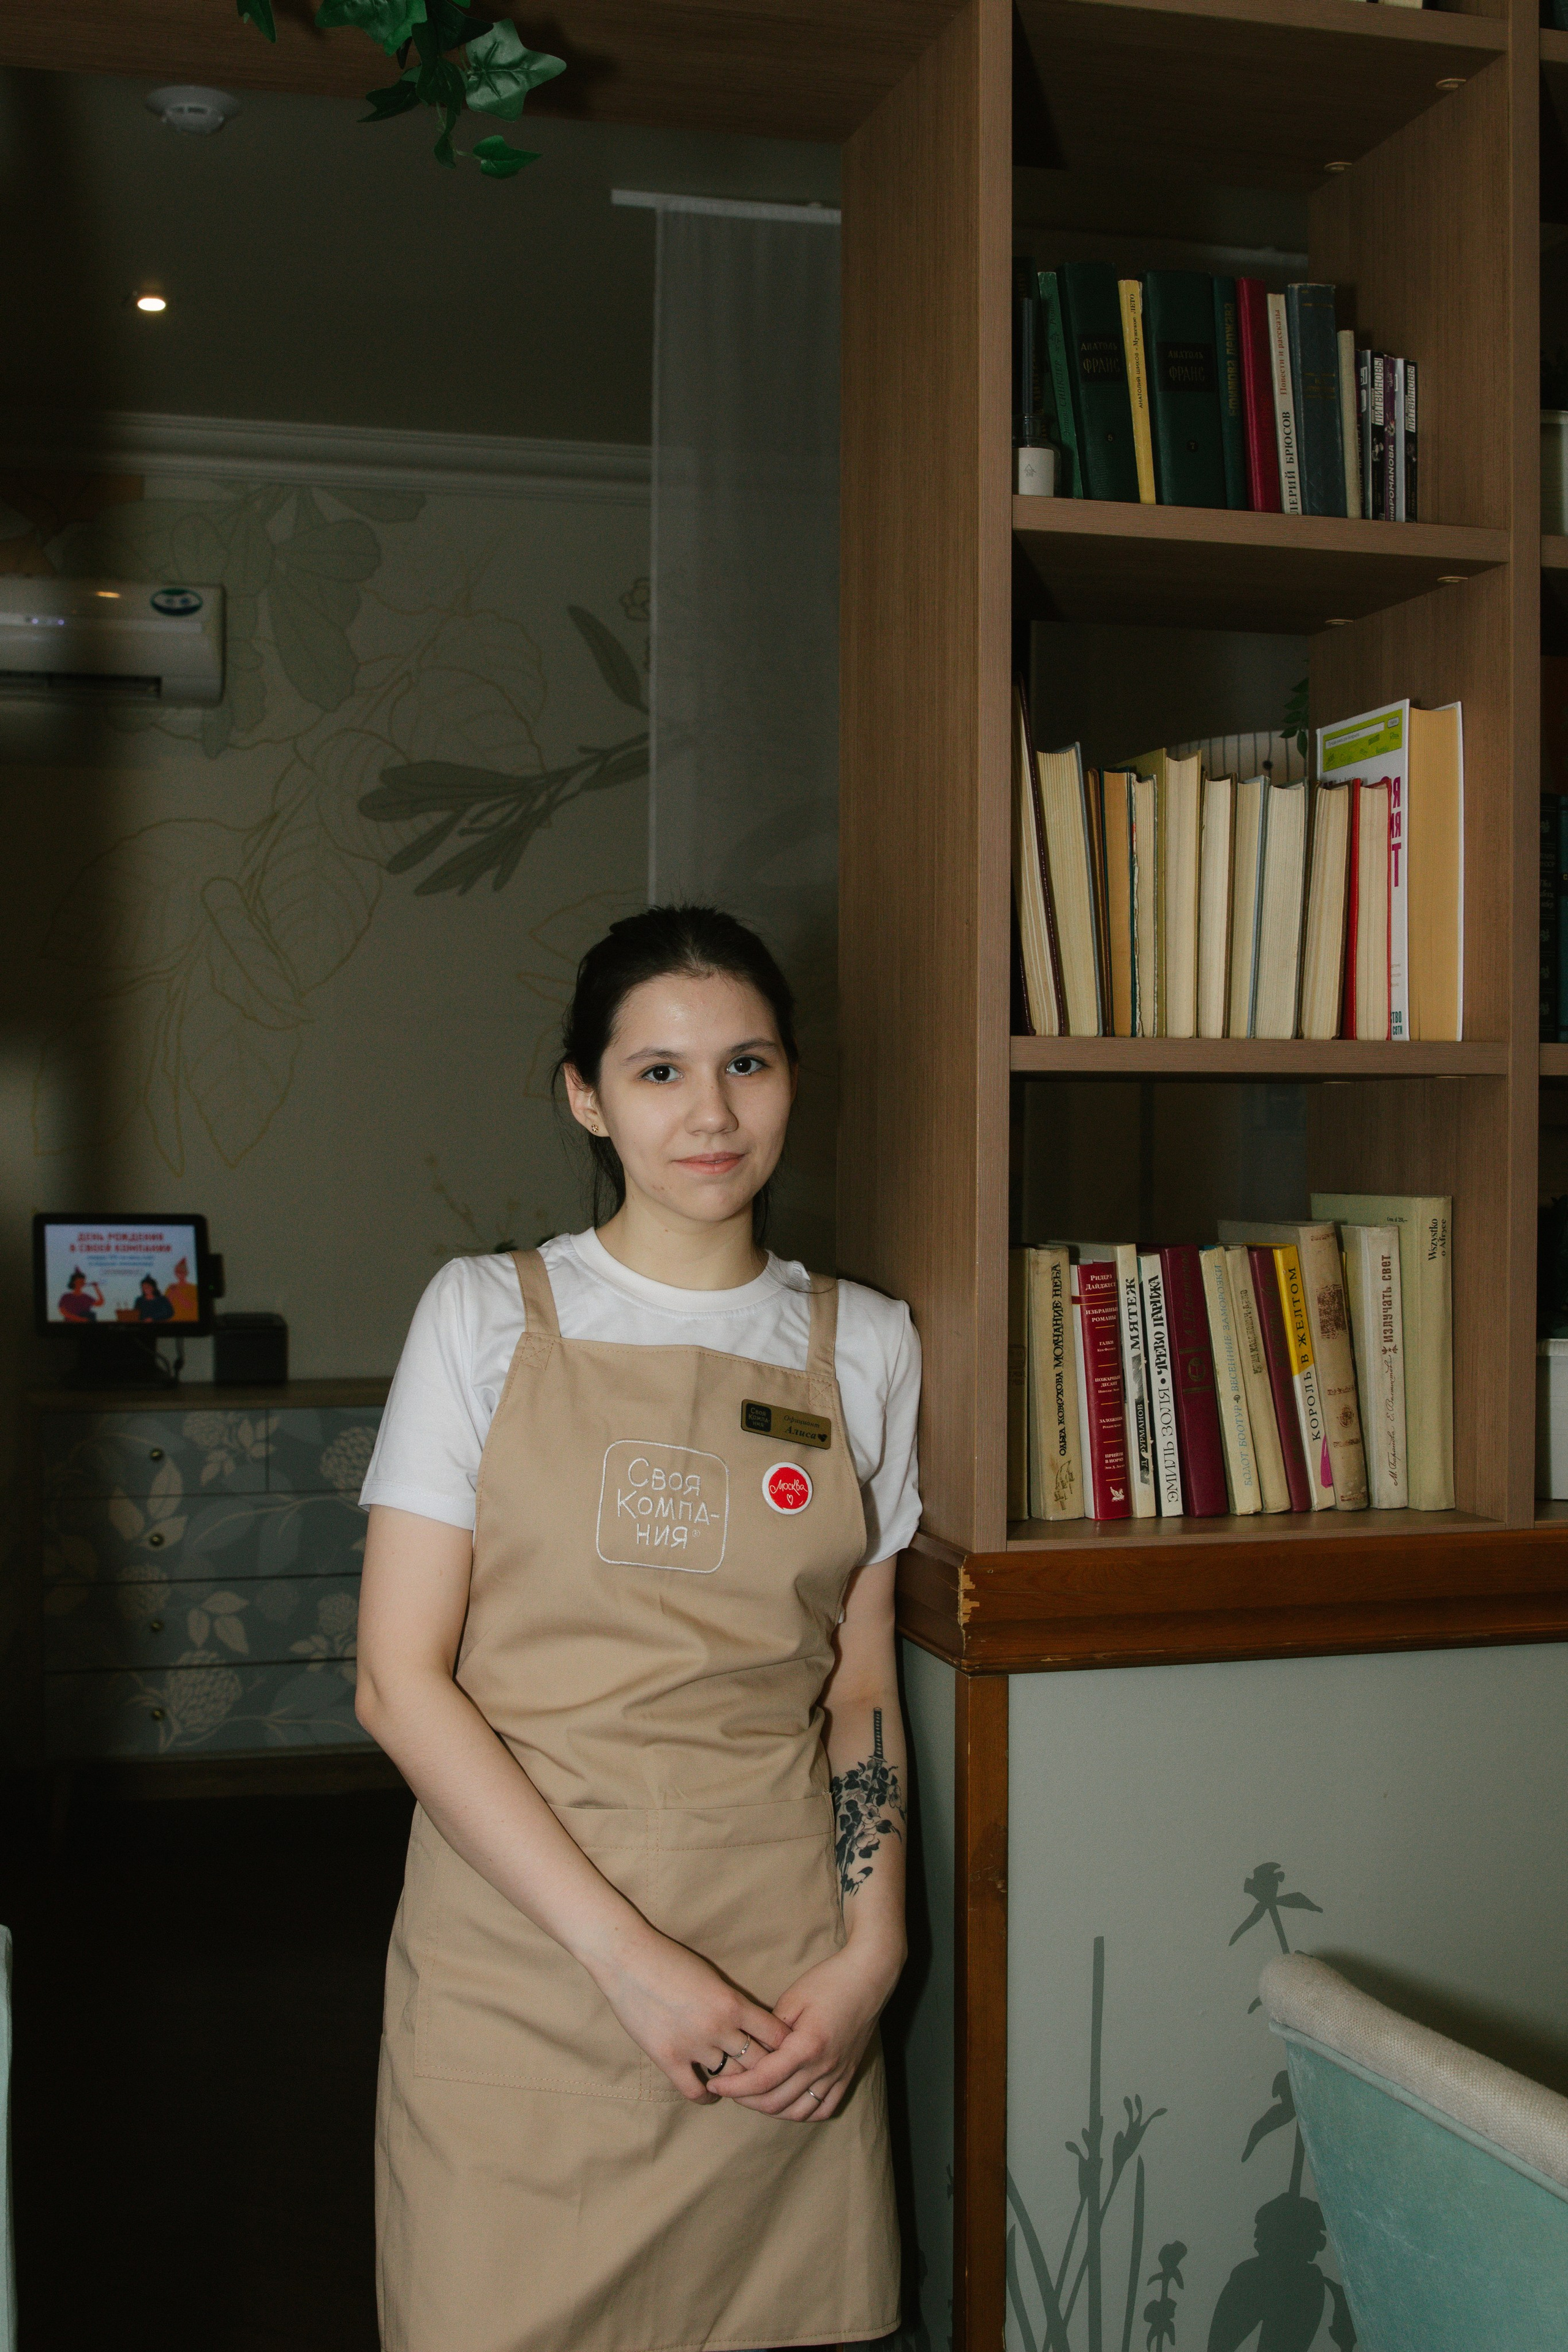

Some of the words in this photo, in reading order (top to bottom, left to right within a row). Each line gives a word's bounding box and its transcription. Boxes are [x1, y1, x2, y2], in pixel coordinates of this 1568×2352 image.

[1275, 309, 1284, 349] рассказы
[1083, 358, 1120, 373] ФРАНС
[1168, 350, 1204, 359] АНАТОЛЬ
[1169, 366, 1205, 382] ФРАНС
[1278, 360, 1287, 396] Повести
[1374, 358, 1383, 425] ЛИТВИНОВЫ
[1281, 412, 1294, 464] БРЮСОВ
[1428, 1218, 1439, 1261] Wszystko
[1051, 1262, 1062, 1298] НЕБА
[1148, 1275, 1164, 1327] ПАРИЖА
[1214, 1265, 1230, 1330] ЗАМОРОЗКИ
[1126, 1278, 1140, 1350] МЯТЕЖ
[1288, 1267, 1307, 1346] ЖЕЛТОМ
[1052, 1300, 1064, 1369] МОЛЧАНИЕ
[1153, 1330, 1169, 1375] ЧРЕВО
[1224, 1335, 1239, 1392] ВЕСЕННИЕ
[1300, 1354, 1310, 1364] В
[750, 1407, 766, 1416] Своя
[1055, 1371, 1065, 1425] КОЖУХОВА
[1158, 1387, 1174, 1437] ЗОЛЯ
[1303, 1371, 1321, 1441] КОРОЛЬ
[784, 1414, 820, 1428] Официант
[784, 1426, 816, 1439] Алиса
[1234, 1404, 1248, 1447] БООТУР
[1240, 1452, 1253, 1486] БОЛОТ
[1387, 1426, 1401, 1469] Баранова
[628, 1458, 701, 1496] Своя
[769, 1479, 808, 1496] Москва
[1160, 1441, 1178, 1502] ЭМИЛЬ
